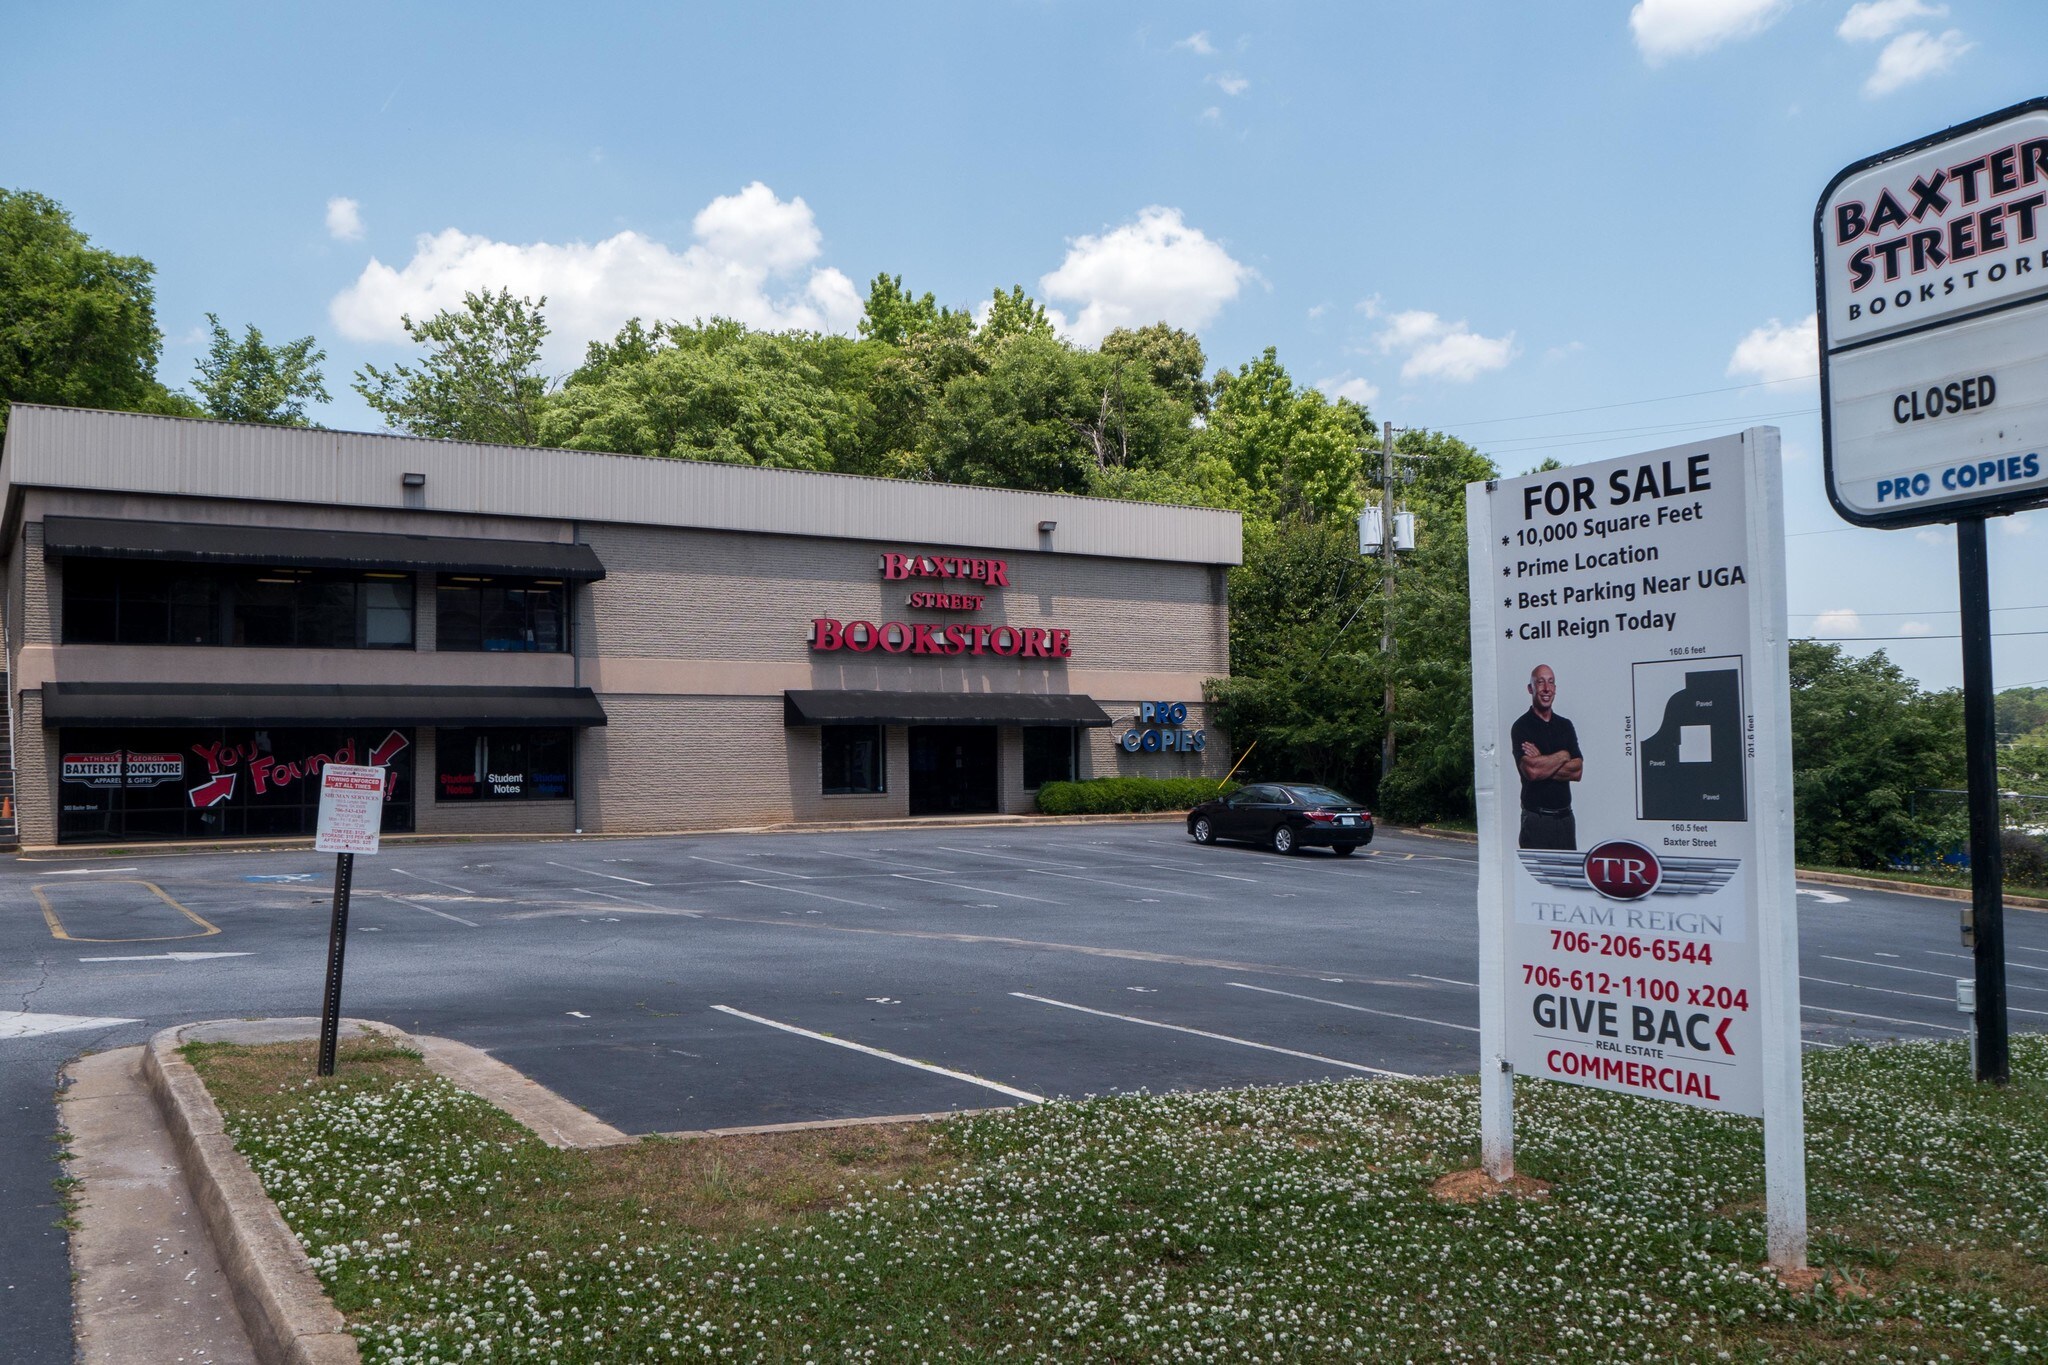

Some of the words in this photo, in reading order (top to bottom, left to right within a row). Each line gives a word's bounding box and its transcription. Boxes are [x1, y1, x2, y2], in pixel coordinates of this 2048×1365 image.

[1836, 136, 2048, 246] BAXTER
[1847, 191, 2046, 293] STREET
[1849, 250, 2048, 321] BOOKSTORE
[1893, 375, 1996, 424] CLOSED
[1523, 476, 1597, 520] FOR
[1609, 454, 1712, 506] SALE
[1877, 472, 1930, 502] PRO
[1942, 454, 2040, 491] COPIES
[1516, 521, 1578, 547] 10,000
[1583, 512, 1650, 538] Square
[1657, 502, 1703, 526] Feet
[881, 553, 1010, 587] BAXTER
[1517, 557, 1569, 579] Prime
[1575, 545, 1659, 571] Location
[910, 591, 986, 611] STREET
[1518, 589, 1557, 609] Best
[1563, 578, 1636, 604] Parking
[1643, 573, 1691, 596] Near
[1698, 565, 1746, 589] UGA
[811, 618, 1072, 658] BOOKSTORE
[1519, 620, 1551, 641] Call
[1557, 616, 1609, 639] Reign
[1616, 609, 1677, 632] Today
[1669, 647, 1690, 656] 160.6
[1691, 646, 1706, 655] feet
[1140, 701, 1188, 725] PRO
[1696, 700, 1713, 708] Paved
[192, 740, 258, 774] You
[1121, 728, 1206, 752] COPIES
[65, 763, 105, 774] BAXTER
[107, 763, 118, 774] ST
[250, 738, 356, 794] Found
[350, 777, 379, 785] ENFORCED
[488, 773, 523, 783] Student
[446, 785, 474, 795] Notes
[494, 784, 520, 794] Notes
[1663, 838, 1690, 847] Baxter
[1692, 838, 1717, 848] Street
[1671, 823, 1692, 832] 160.5
[1693, 824, 1708, 833] feet
[1592, 857, 1651, 885] TR
[1531, 902, 1615, 927] TEAM
[1627, 908, 1723, 935] REIGN
[1550, 930, 1712, 966] 706-206-6544
[1522, 964, 1680, 1003] 706-612-1100
[1687, 984, 1749, 1012] x204
[1532, 993, 1618, 1038] GIVE
[1596, 1040, 1623, 1053] REAL
[1625, 1044, 1664, 1059] ESTATE
[1547, 1049, 1720, 1101] COMMERCIAL
